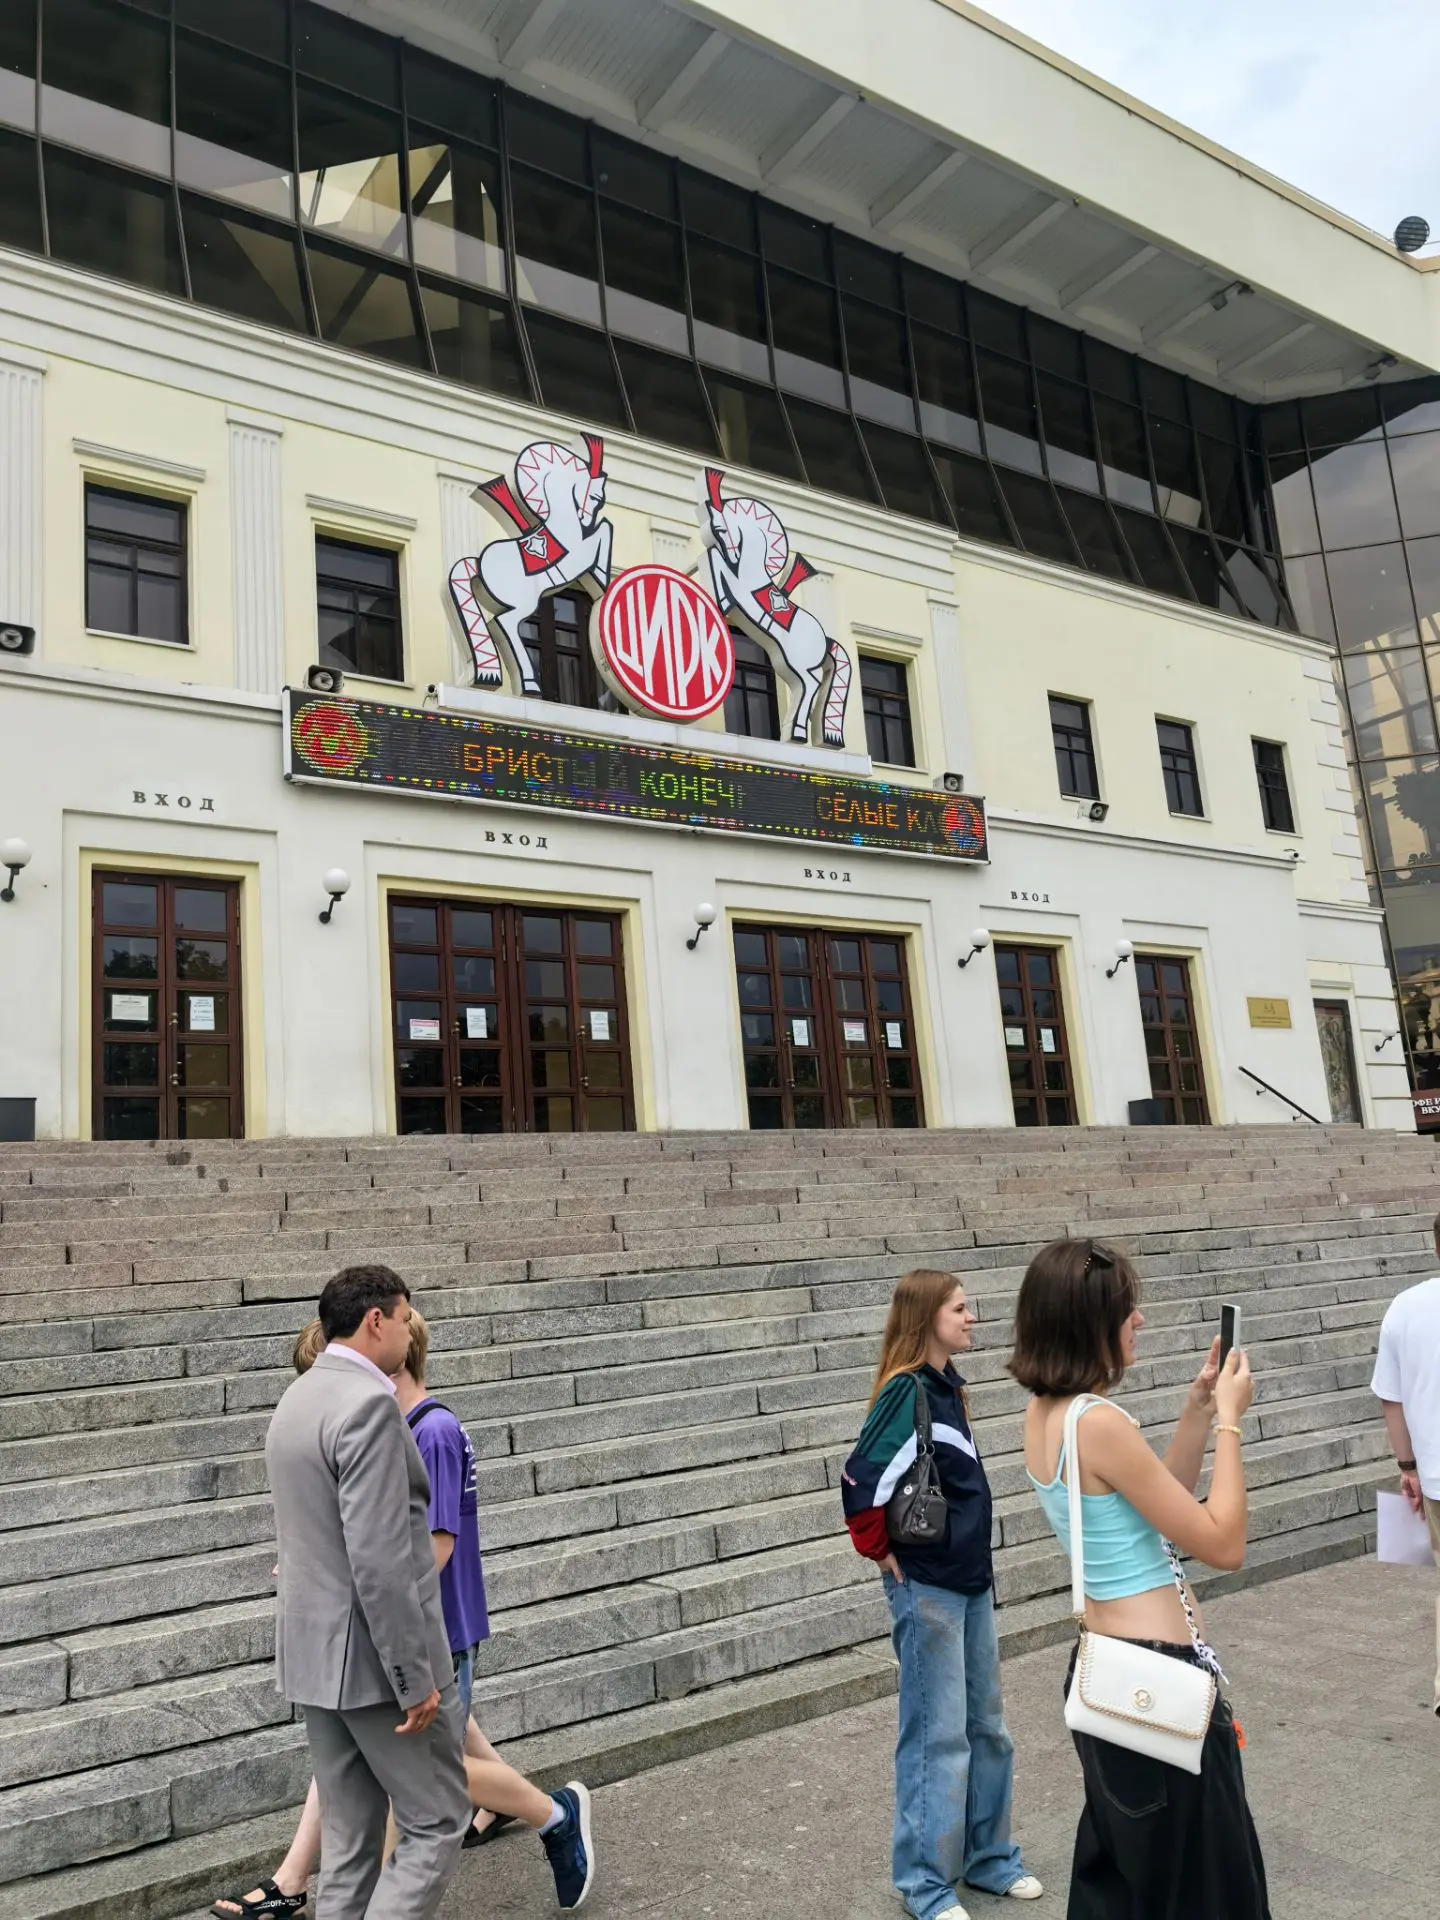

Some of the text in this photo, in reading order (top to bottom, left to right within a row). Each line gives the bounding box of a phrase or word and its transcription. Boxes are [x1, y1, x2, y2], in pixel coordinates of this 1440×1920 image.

[613, 578, 723, 707] ЦИРК
[132, 790, 215, 812] ВХОД
[485, 831, 548, 849] ВХОД
[804, 868, 851, 883] ВХОД
[1011, 891, 1049, 903] ВХОД
